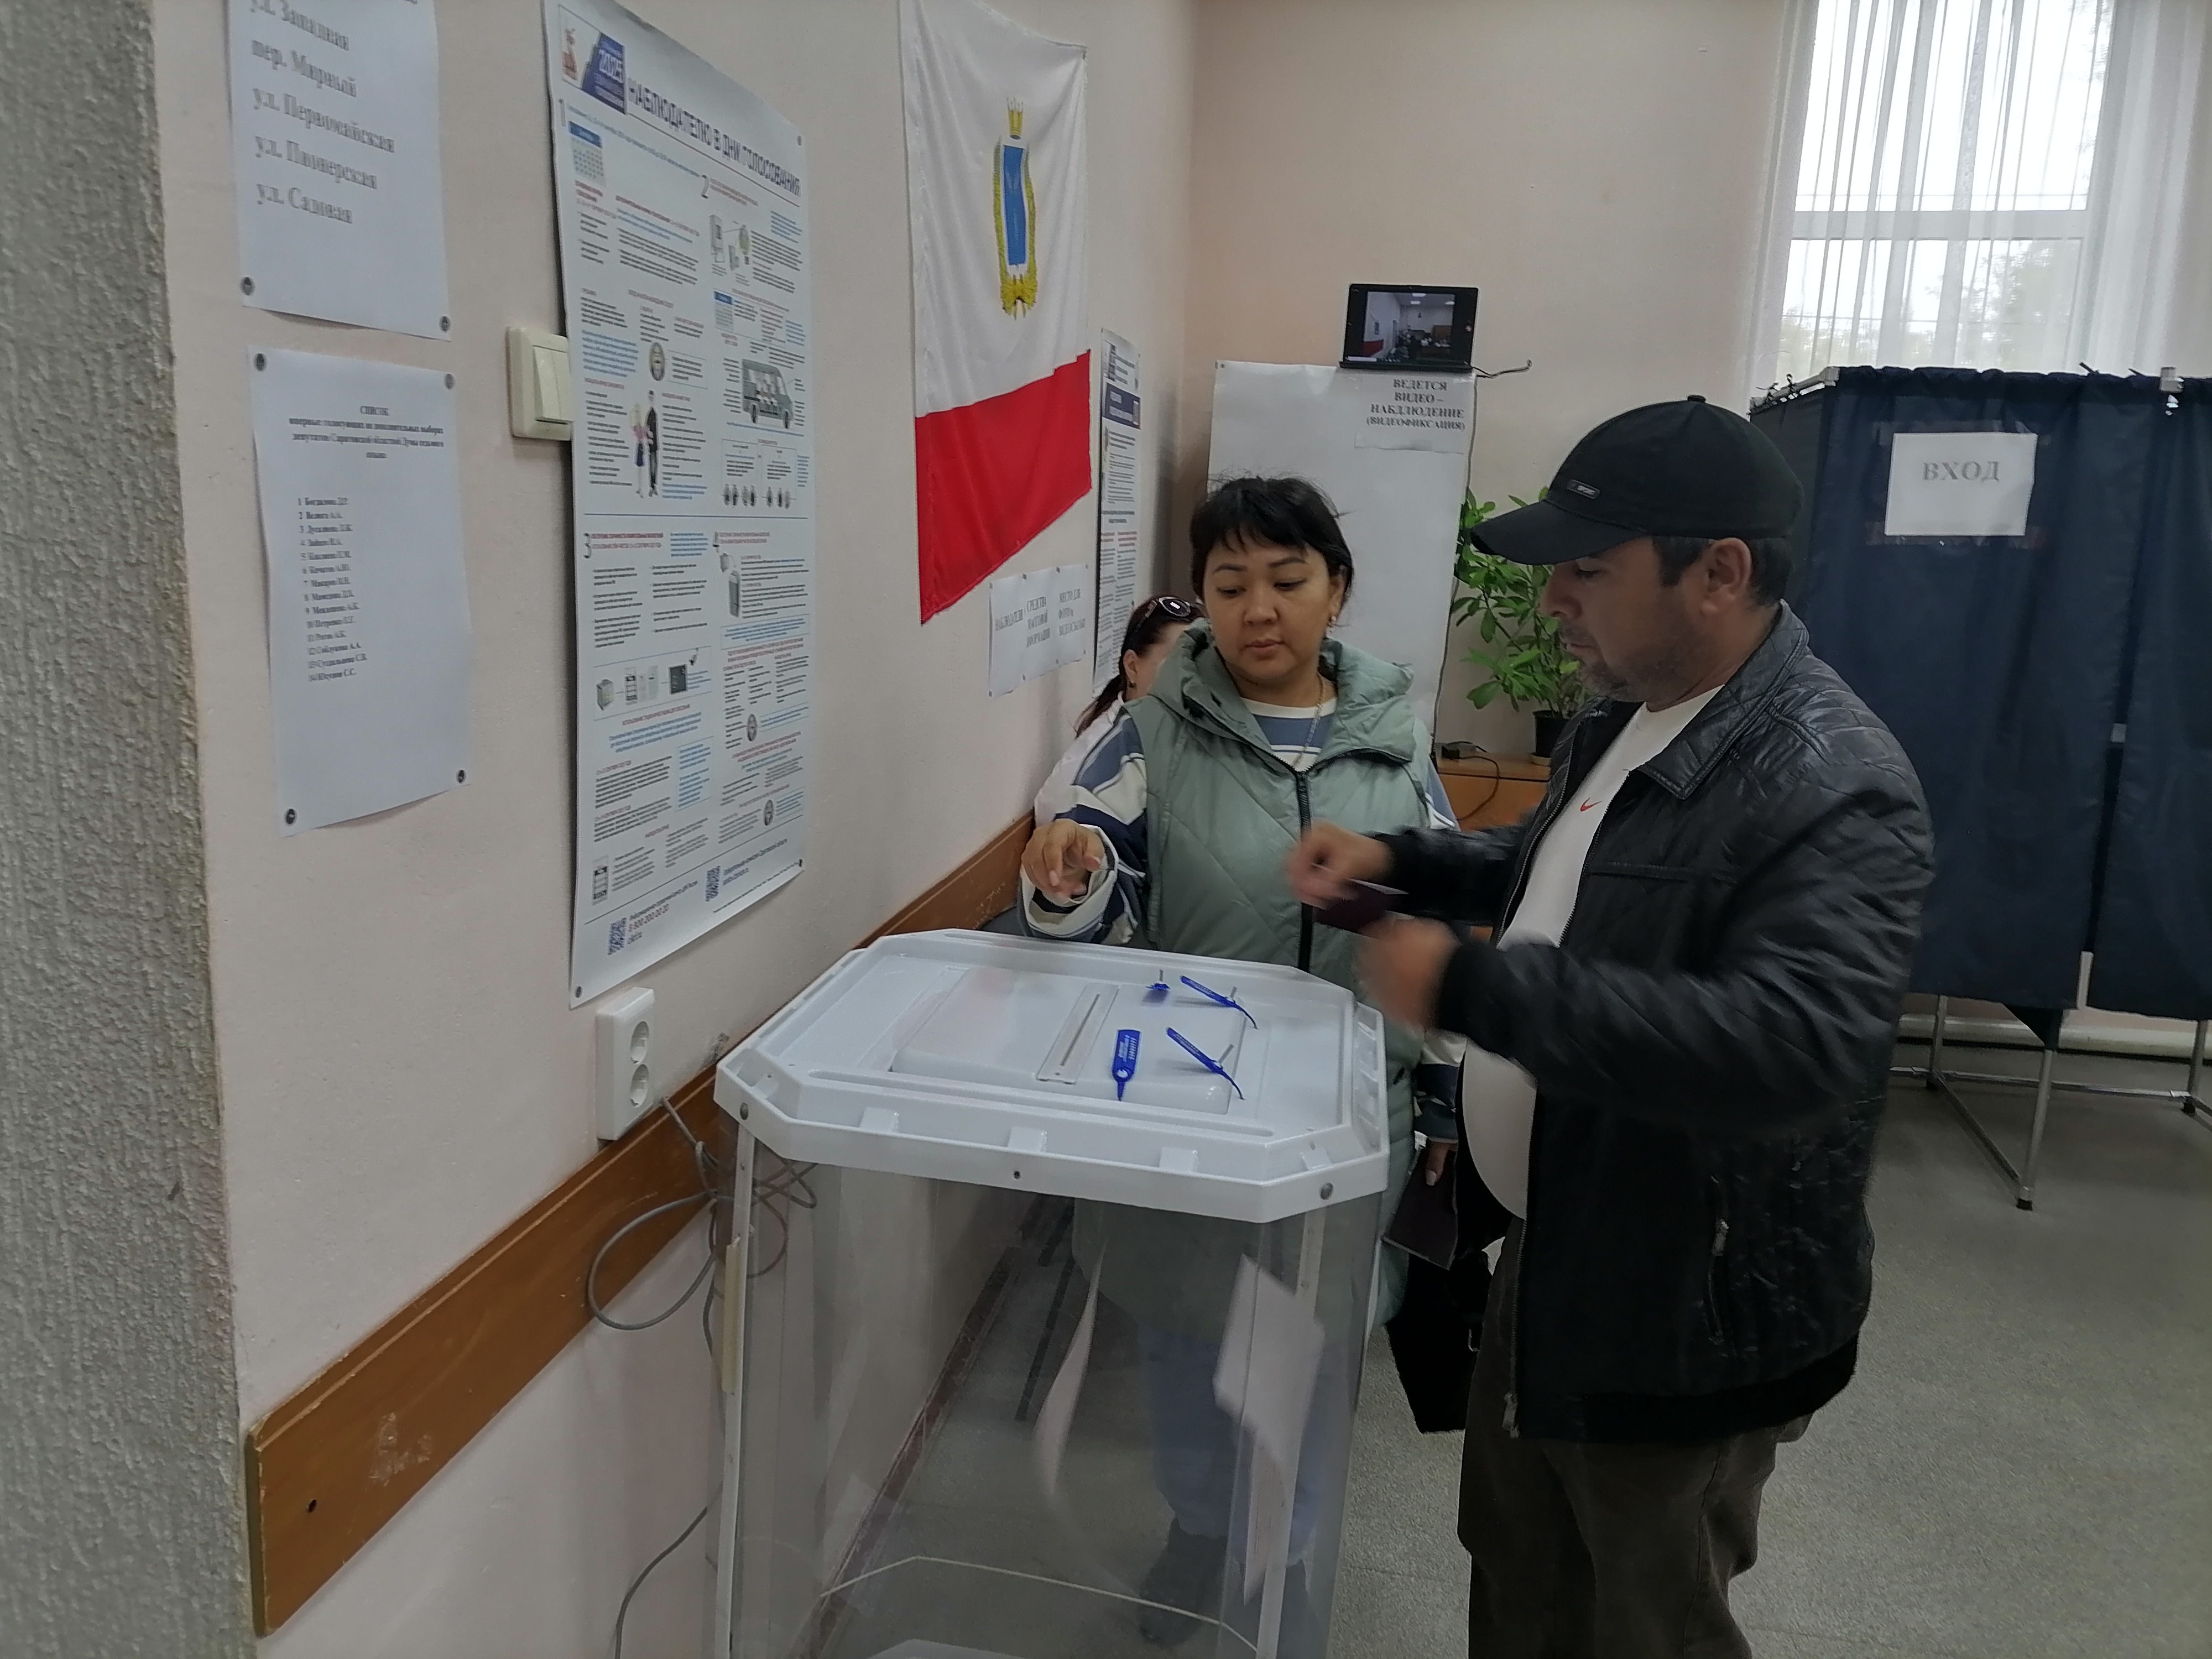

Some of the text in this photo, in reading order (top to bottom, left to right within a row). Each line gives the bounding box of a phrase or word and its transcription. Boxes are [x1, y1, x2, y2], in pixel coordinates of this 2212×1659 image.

[627, 77, 713, 145] НАБЛЮДАТЕЛЮ
[741, 145, 801, 197] ГОЛОСОВАНИЯ
[1393, 378, 1447, 391] ВЕДЕТСЯ
[1370, 404, 1465, 419] НАБЛЮДЕНИЕ
[1923, 461, 2001, 482] ВХОД
